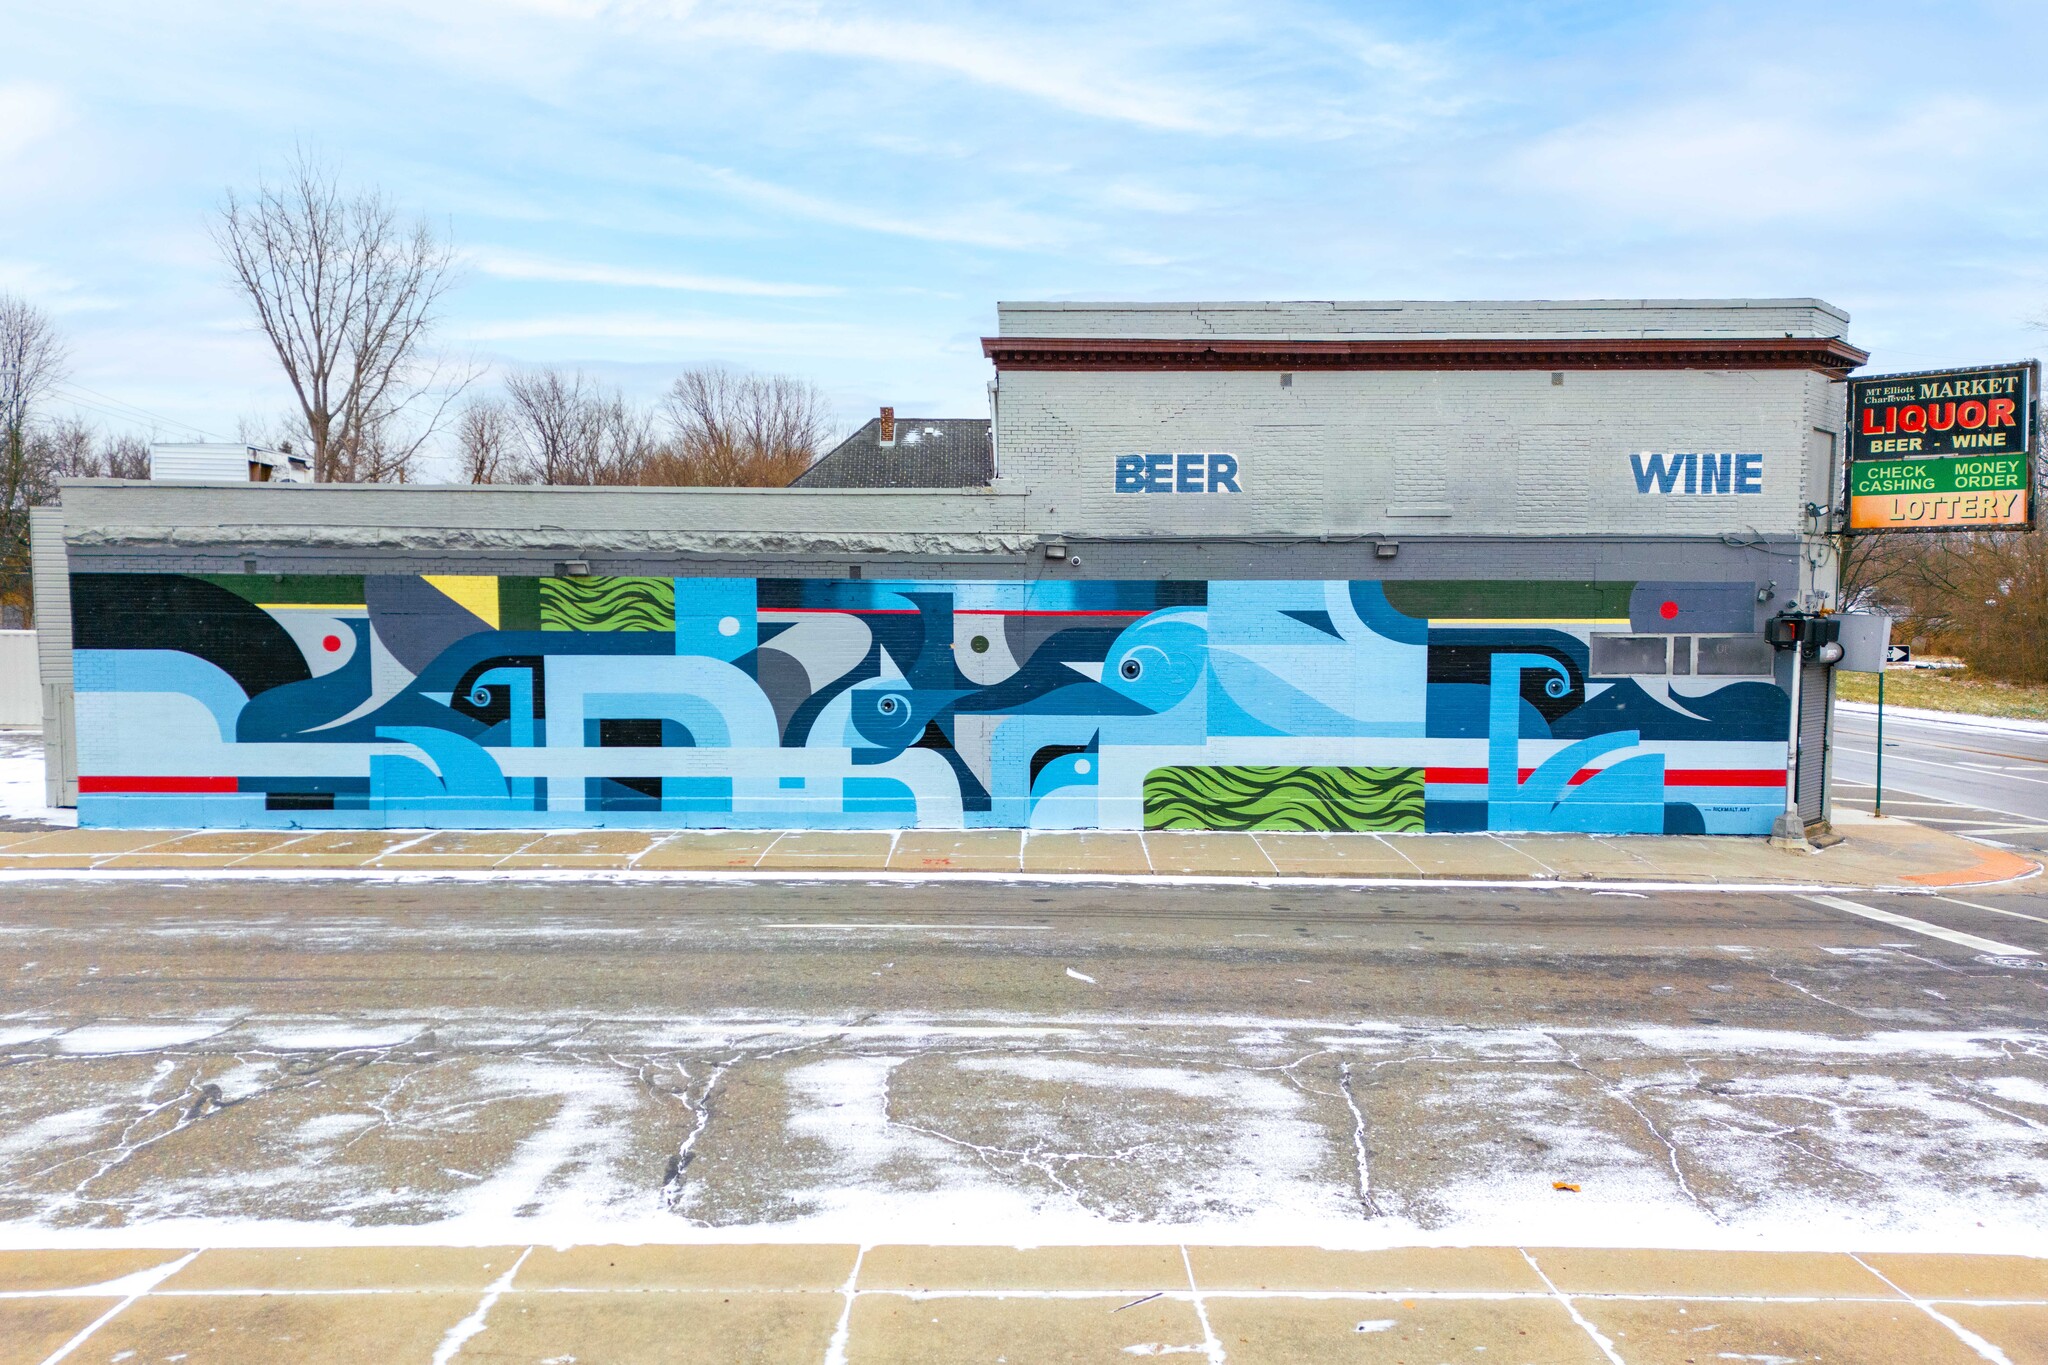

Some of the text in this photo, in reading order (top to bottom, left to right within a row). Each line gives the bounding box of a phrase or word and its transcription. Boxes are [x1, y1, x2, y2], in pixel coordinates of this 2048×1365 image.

[1866, 385, 1915, 396] MT Elliott
[1919, 376, 2019, 400] MARKET
[1862, 398, 2016, 435] LIQUOR
[1870, 437, 1923, 453] BEER
[1952, 433, 2007, 449] WINE
[1115, 453, 1243, 493] BEER
[1629, 453, 1763, 494] WINE
[1867, 465, 1927, 479] CHECK
[1954, 460, 2020, 475] MONEY
[1859, 478, 1935, 492] CASHING
[1955, 474, 2018, 488] ORDER
[1890, 493, 2018, 521] LOTTERY
